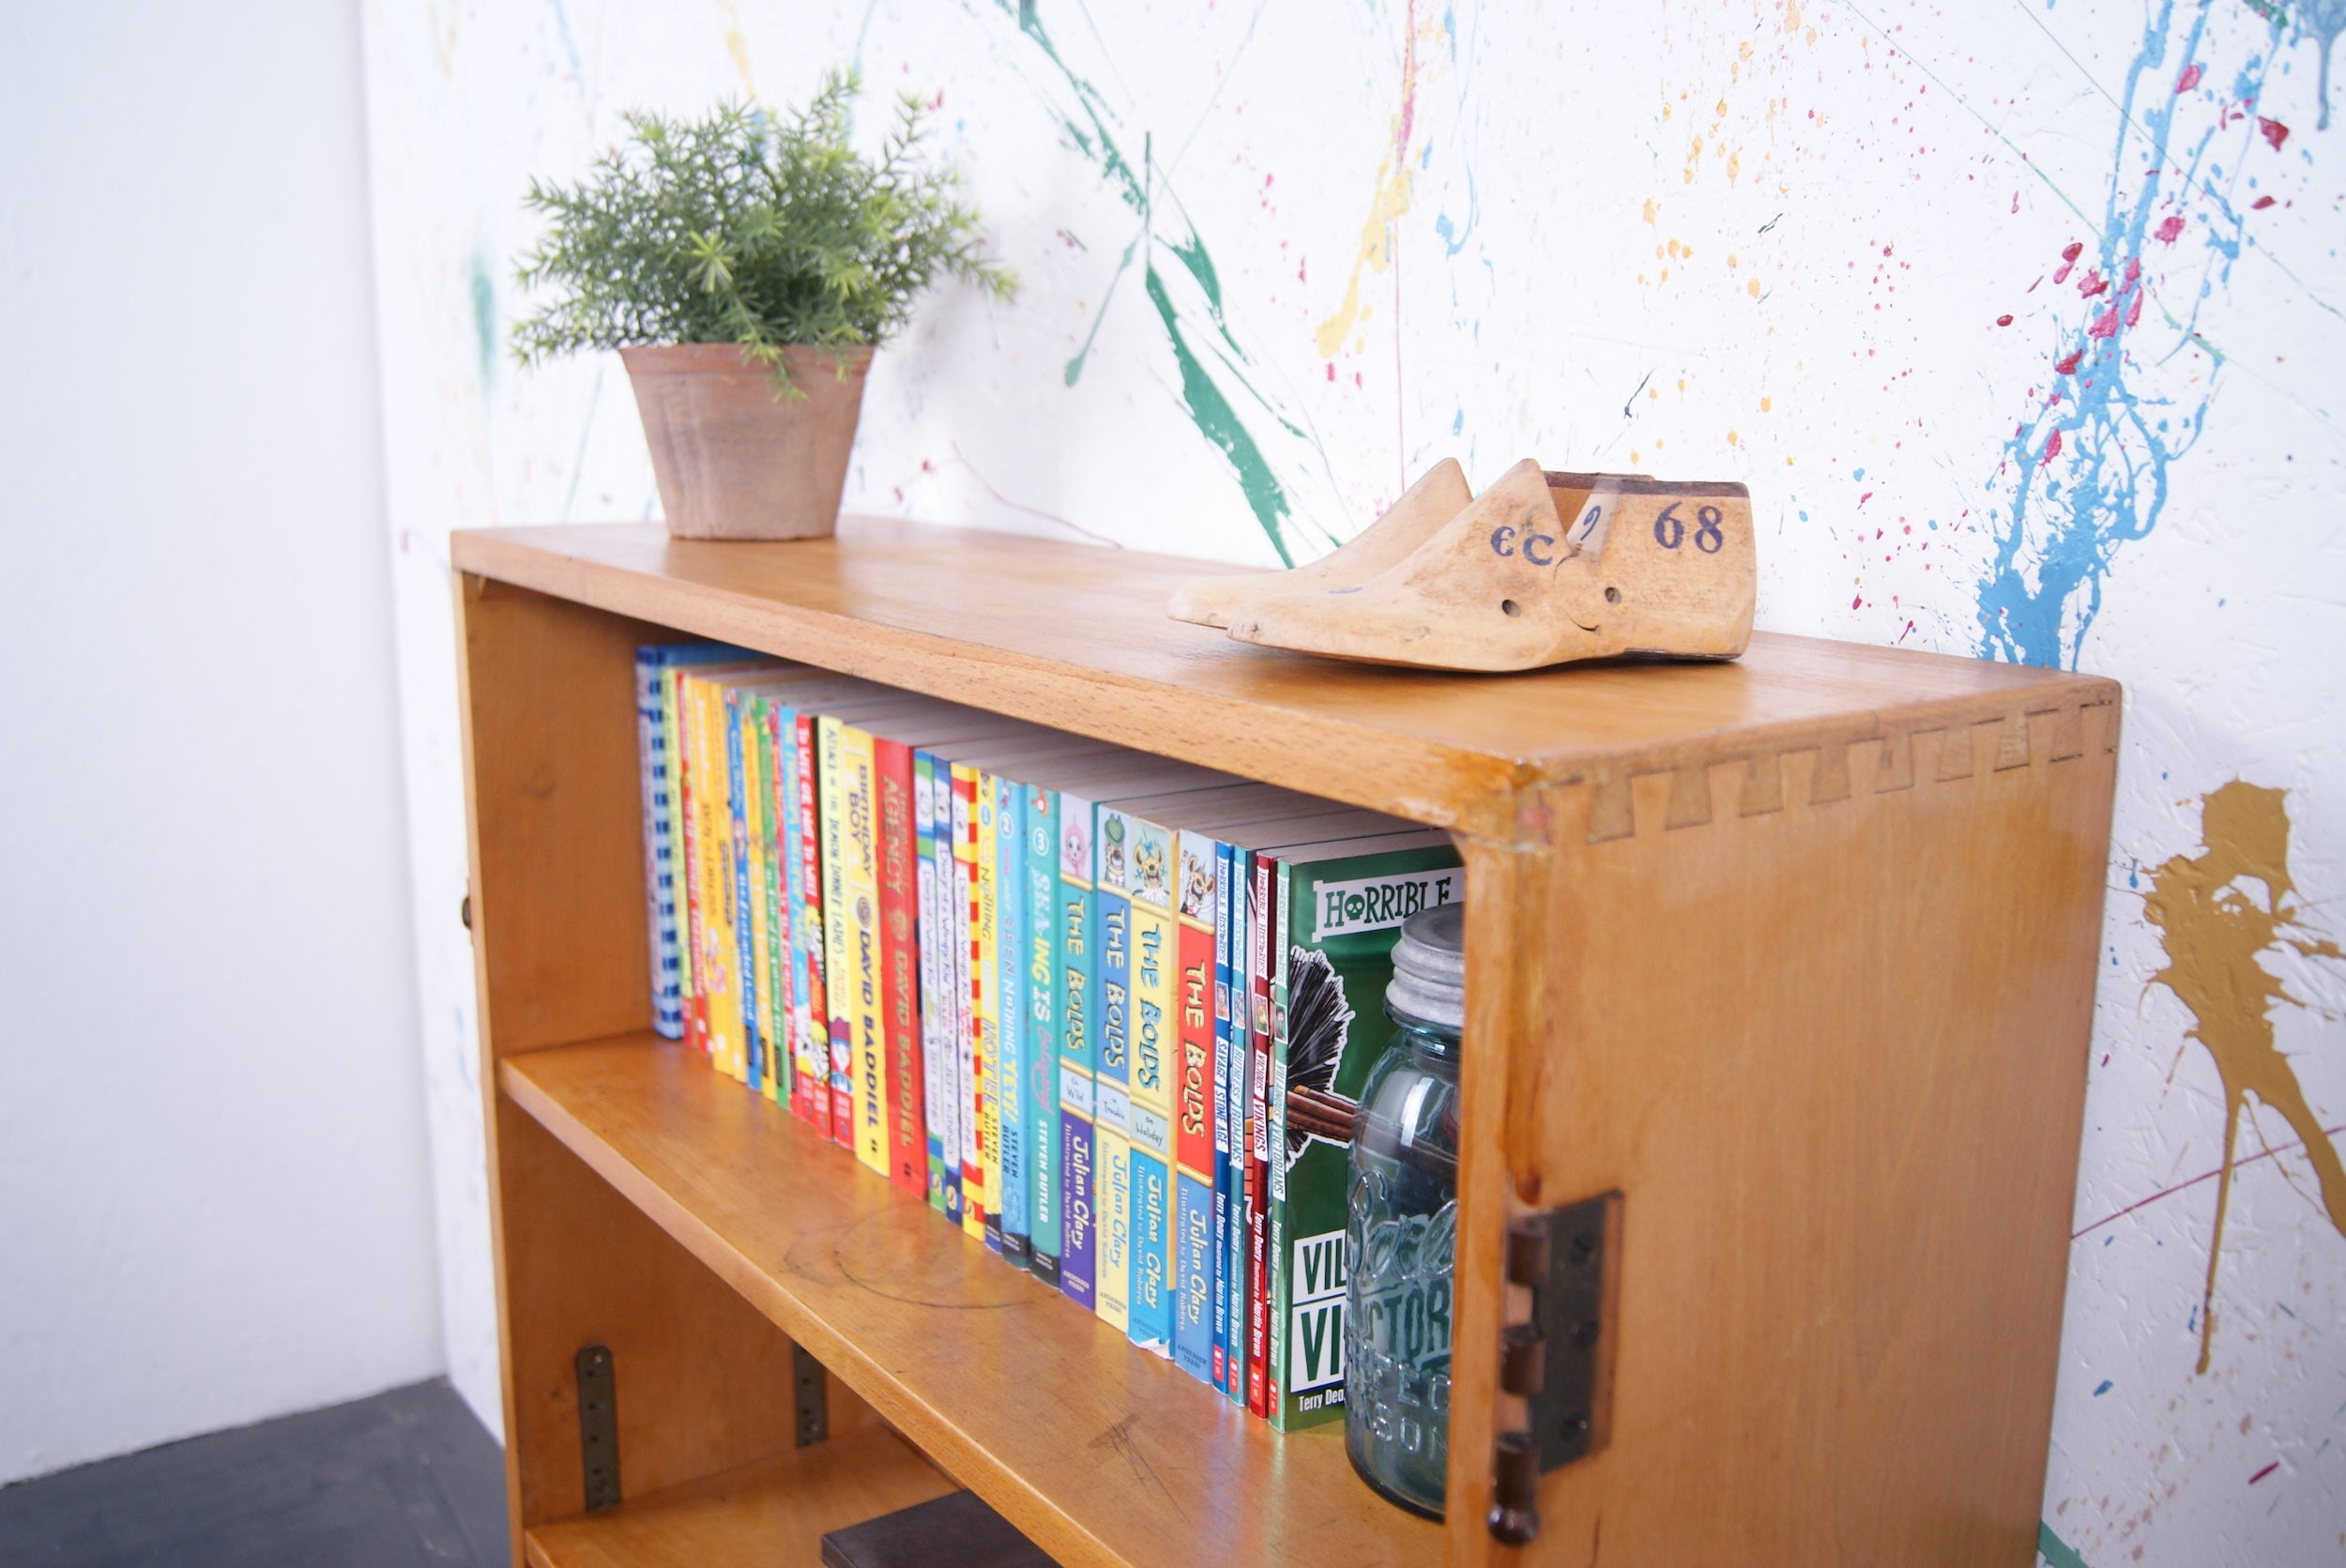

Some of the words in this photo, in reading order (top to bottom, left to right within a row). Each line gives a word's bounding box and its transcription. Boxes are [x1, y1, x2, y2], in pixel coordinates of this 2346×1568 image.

[1653, 501, 1723, 554] 68
[849, 792, 861, 844] BOY
[859, 765, 873, 879] BIRTHDAY
[882, 776, 903, 897] AGENCY
[1258, 871, 1268, 920] HORRIBLE
[1002, 916, 1014, 974] SEEN
[1067, 898, 1086, 955] THE
[1105, 908, 1126, 968] THE
[1257, 923, 1267, 974] HISTORIES
[860, 931, 873, 1006] DAVID
[1141, 925, 1162, 988] THE
[893, 949, 910, 1028] DAVID
[1034, 986, 1051, 1023] IS
[1066, 968, 1086, 1052] BOLDS
[1184, 961, 1207, 1028] THE
[1003, 980, 1016, 1054] NOTHING
[1104, 981, 1126, 1069] BOLDS
[981, 1018, 999, 1107] HOTEL
[1137, 1000, 1162, 1090] BOLDS
[1217, 1043, 1227, 1081] SAVAGE
[863, 1014, 878, 1128] BADDIEL
[897, 1034, 913, 1147] BADDIEL
[1067, 1085, 1084, 1102] Wild
[1181, 1043, 1208, 1137] BOLDS
[1232, 1050, 1244, 1098] RUTHLESS
[1257, 1054, 1267, 1091] VICIOUS
[1274, 1065, 1286, 1119] VILLAINOUS
[1216, 1090, 1226, 1122] STONE
[1255, 1104, 1266, 1152] VIKINGS
[991, 1118, 999, 1165] STEVEN
[1001, 1125, 1011, 1175] BUTLER
[1011, 1131, 1019, 1179] STEVEN
[1039, 1119, 1049, 1171] STEVEN
[1064, 1124, 1073, 1177] Illustrated
[1136, 1121, 1163, 1147] Holiday
[1216, 1124, 1226, 1145] AGE
[1231, 1106, 1242, 1163] ROMANS
[1073, 1136, 1090, 1195] Julian
[1112, 1154, 1126, 1213] Julian
[1272, 1129, 1284, 1194] VICTORIANS
[1038, 1172, 1048, 1223] BUTLER
[1064, 1191, 1073, 1219] David
[1136, 1165, 1145, 1219] Illustrated
[1147, 1174, 1163, 1240] Julian
[1180, 1187, 1188, 1243] Illustrated
[1215, 1192, 1226, 1214] Terry
[1230, 1203, 1241, 1225] Terry
[1064, 1222, 1073, 1257] Roberts
[1072, 1199, 1089, 1250] Clary
[1109, 1219, 1126, 1268] Clary
[1189, 1209, 1208, 1270] Julian
[1215, 1214, 1226, 1240] Deary
[1230, 1226, 1241, 1253] Deary
[1254, 1211, 1264, 1235] Terry
[1254, 1236, 1263, 1260] Deary
[1272, 1220, 1282, 1244] Terry
[1145, 1252, 1162, 1309] Clary
[1272, 1244, 1282, 1270] Deary
[1135, 1268, 1144, 1305] Roberts
[1179, 1292, 1187, 1331] Roberts
[1188, 1273, 1207, 1325] Clary
[1215, 1278, 1225, 1304] Martin
[1230, 1290, 1240, 1316] Martin
[1215, 1304, 1224, 1333] Brown
[1230, 1316, 1239, 1347] Brown
[1253, 1300, 1262, 1326] Martin
[1271, 1309, 1280, 1334] Martin
[1252, 1326, 1261, 1357] Brown
[1270, 1334, 1279, 1366] Brown
[1299, 1394, 1323, 1411] Terry
[1326, 1389, 1346, 1405] Dea
